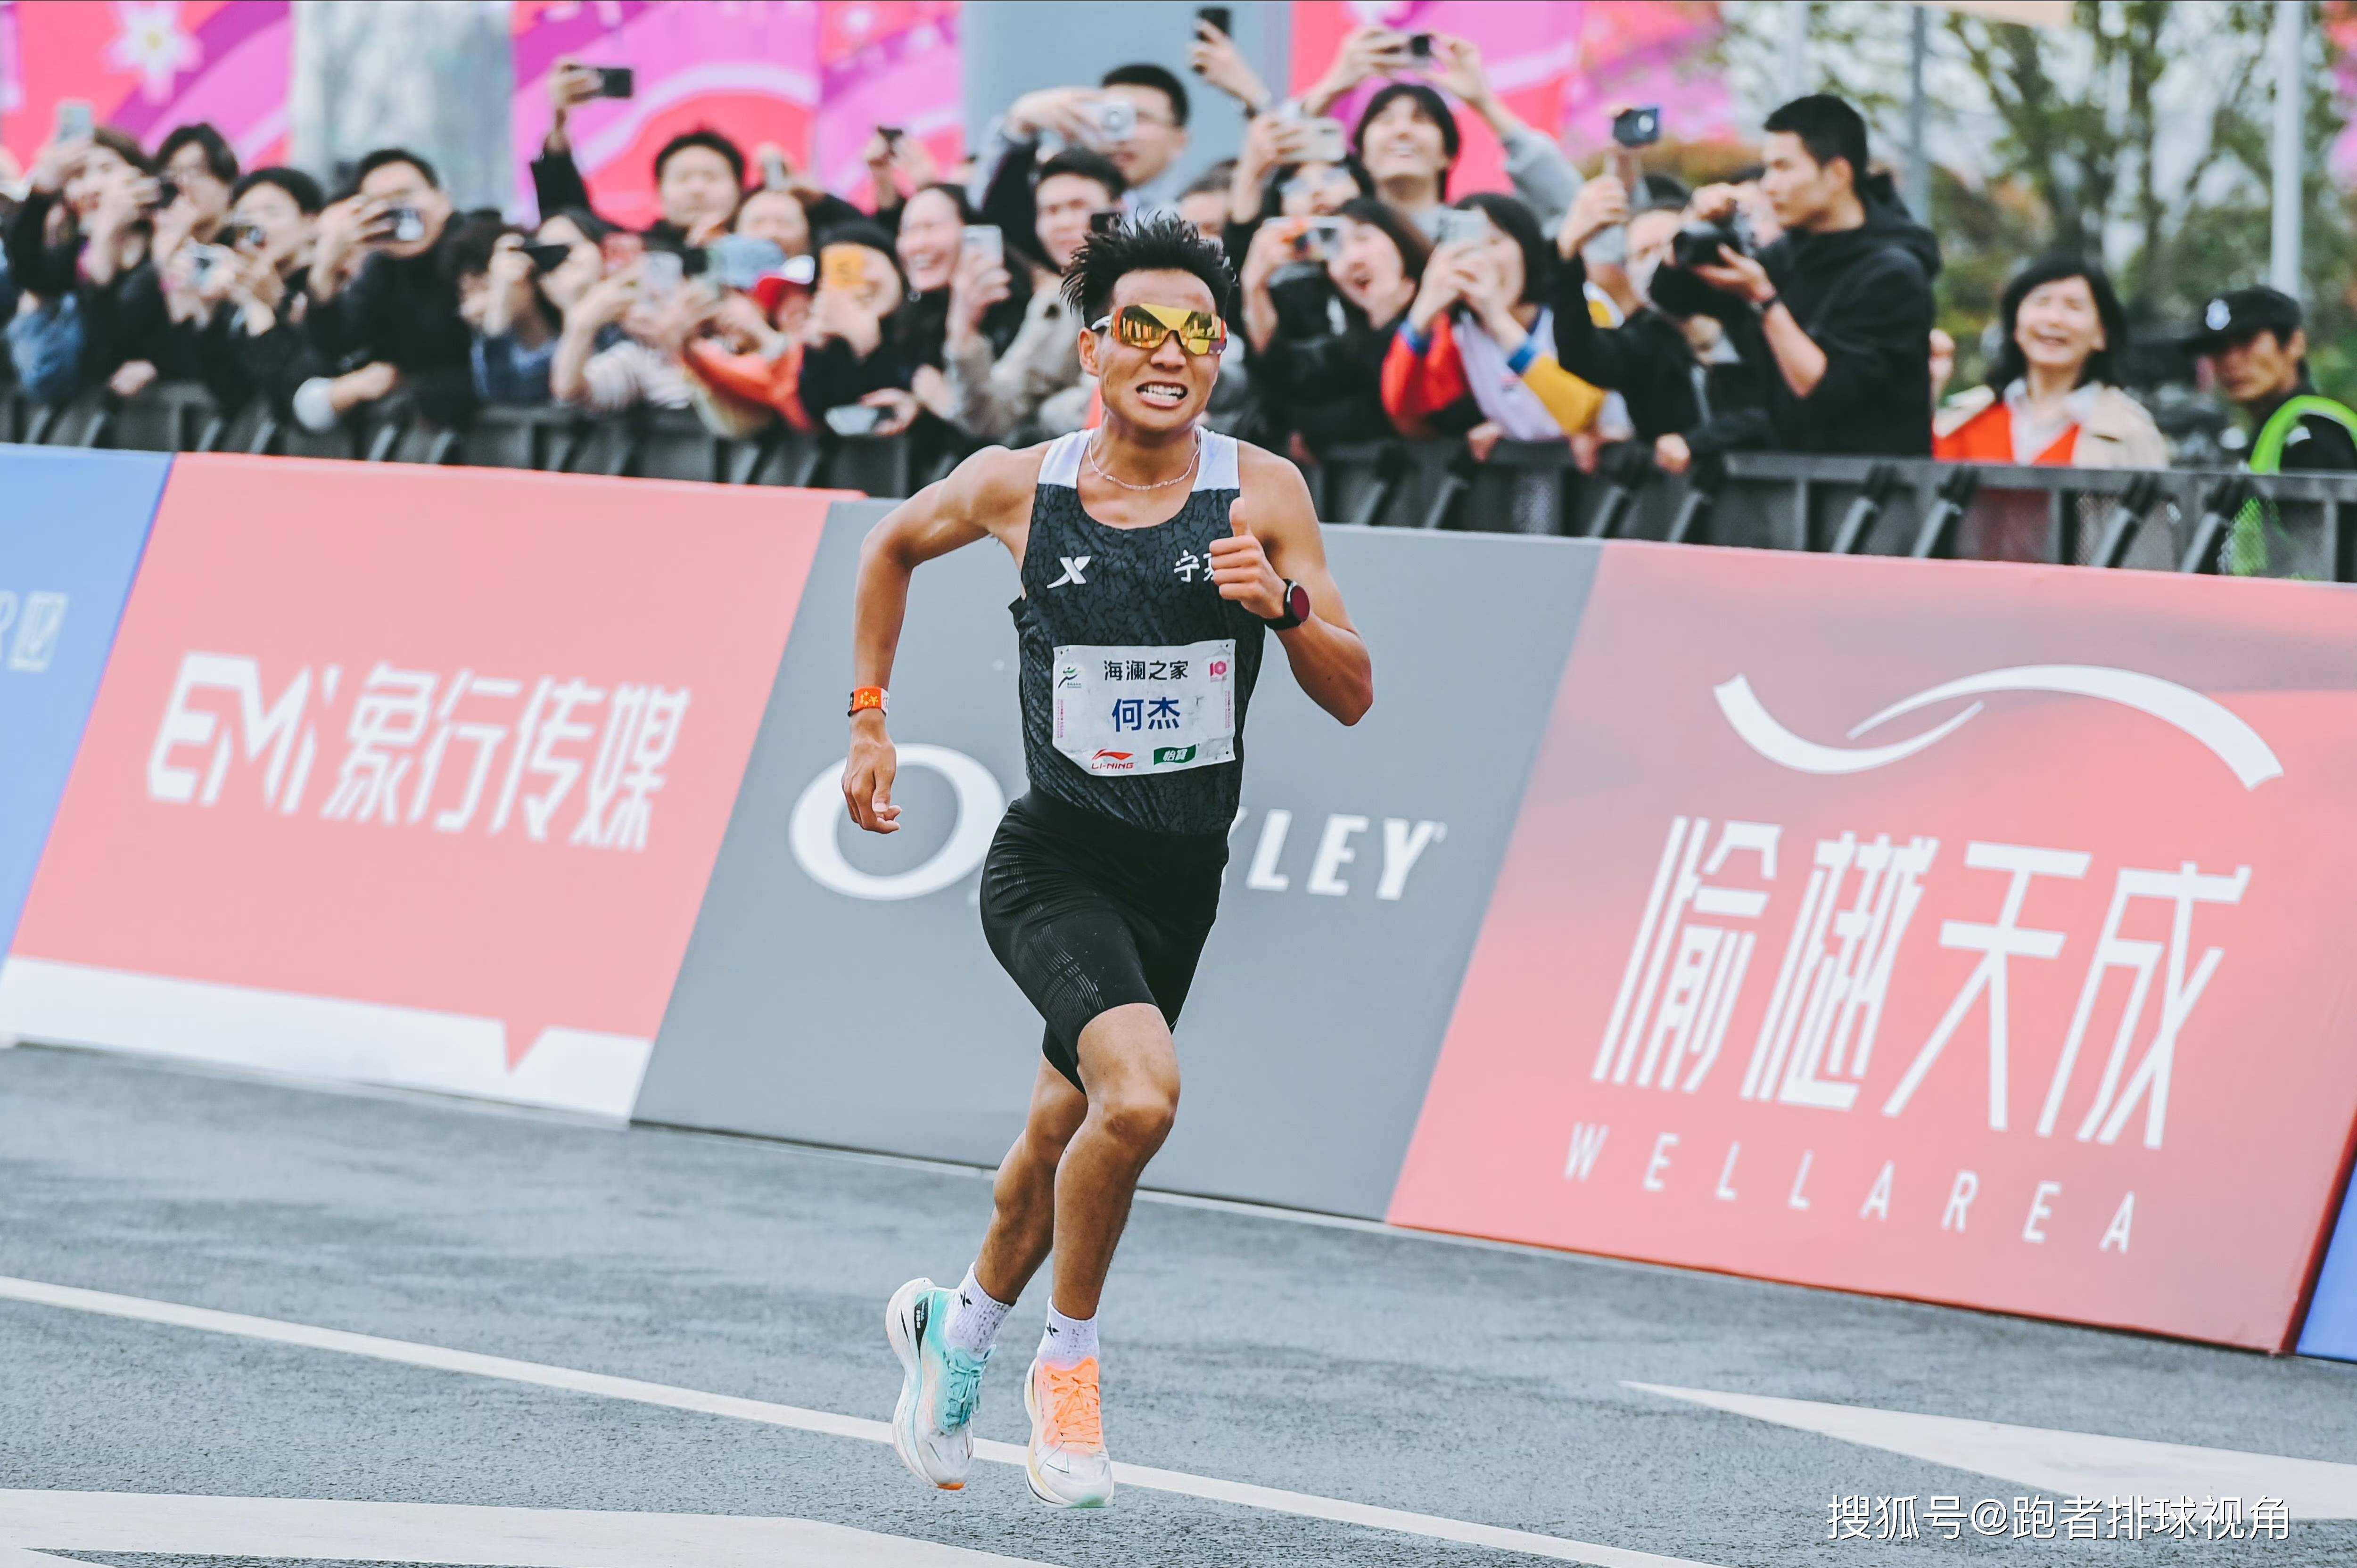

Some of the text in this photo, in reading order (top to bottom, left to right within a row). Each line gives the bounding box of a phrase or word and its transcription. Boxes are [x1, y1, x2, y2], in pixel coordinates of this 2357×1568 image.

[1104, 660, 1188, 681] 海澜之家
[319, 660, 691, 852] 象行传媒
[1112, 697, 1180, 732] 何杰
[1565, 1121, 2135, 1254] WELLAREA
